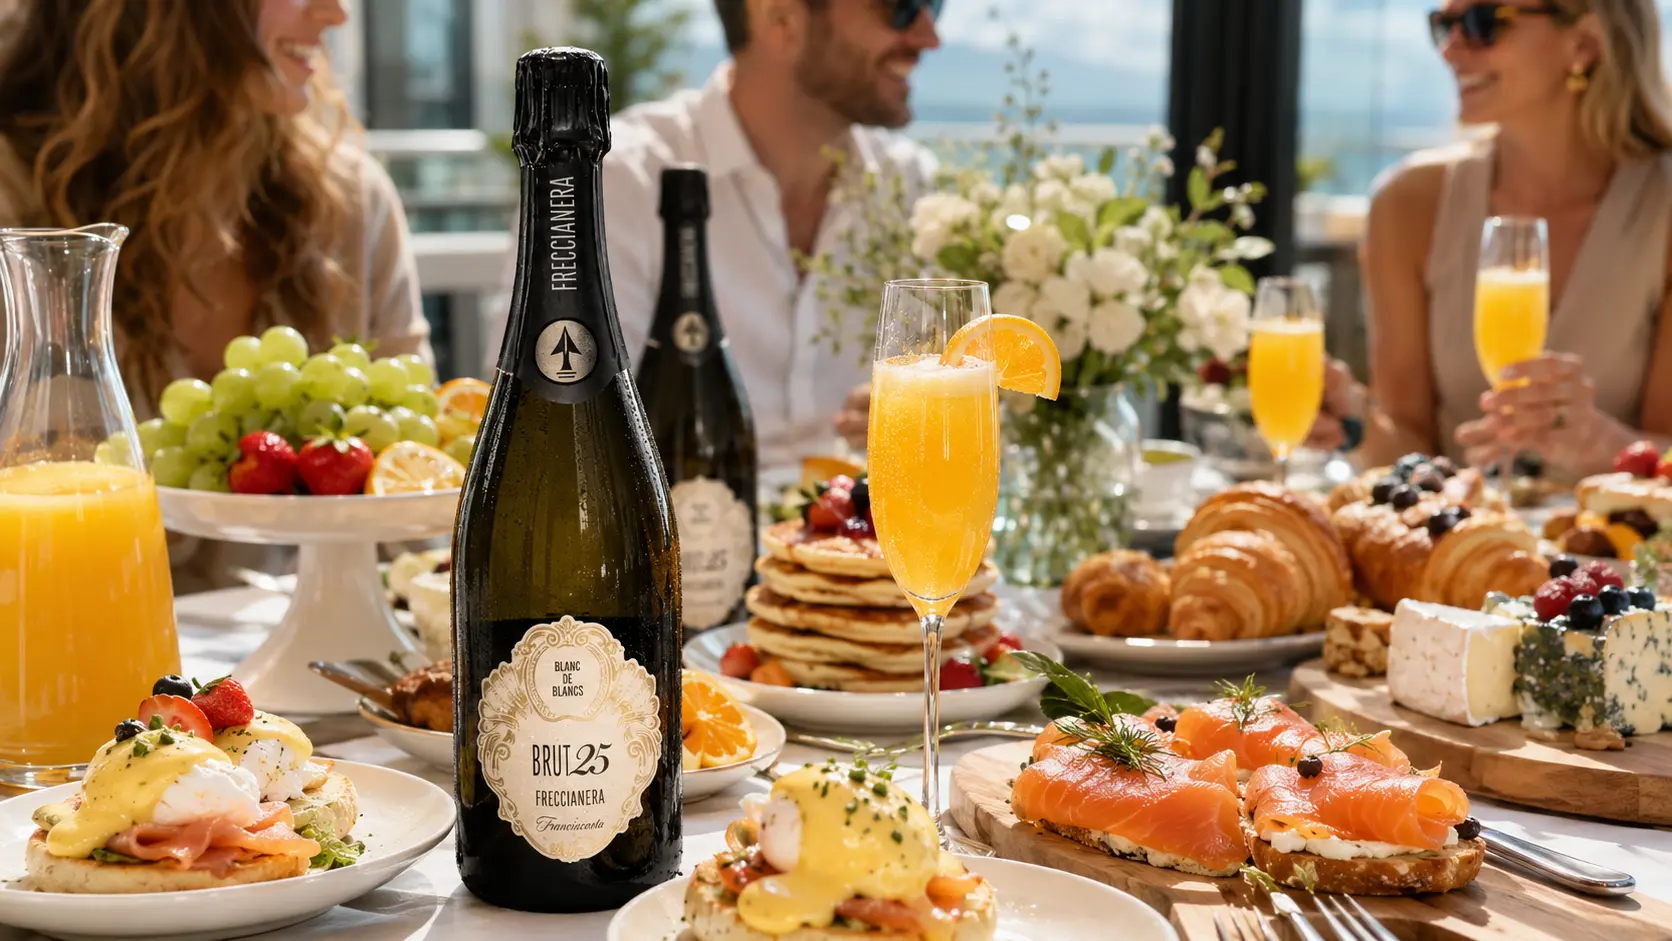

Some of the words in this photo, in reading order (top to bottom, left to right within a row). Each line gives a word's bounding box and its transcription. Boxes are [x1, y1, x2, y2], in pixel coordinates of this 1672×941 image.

[550, 176, 577, 291] FRECCIANERA
[554, 660, 581, 672] BLANC
[562, 672, 573, 684] DE
[552, 684, 584, 697] BLANCS
[532, 744, 571, 777] BRUT
[568, 742, 613, 776] 25
[535, 788, 605, 807] FRECCIANERA
